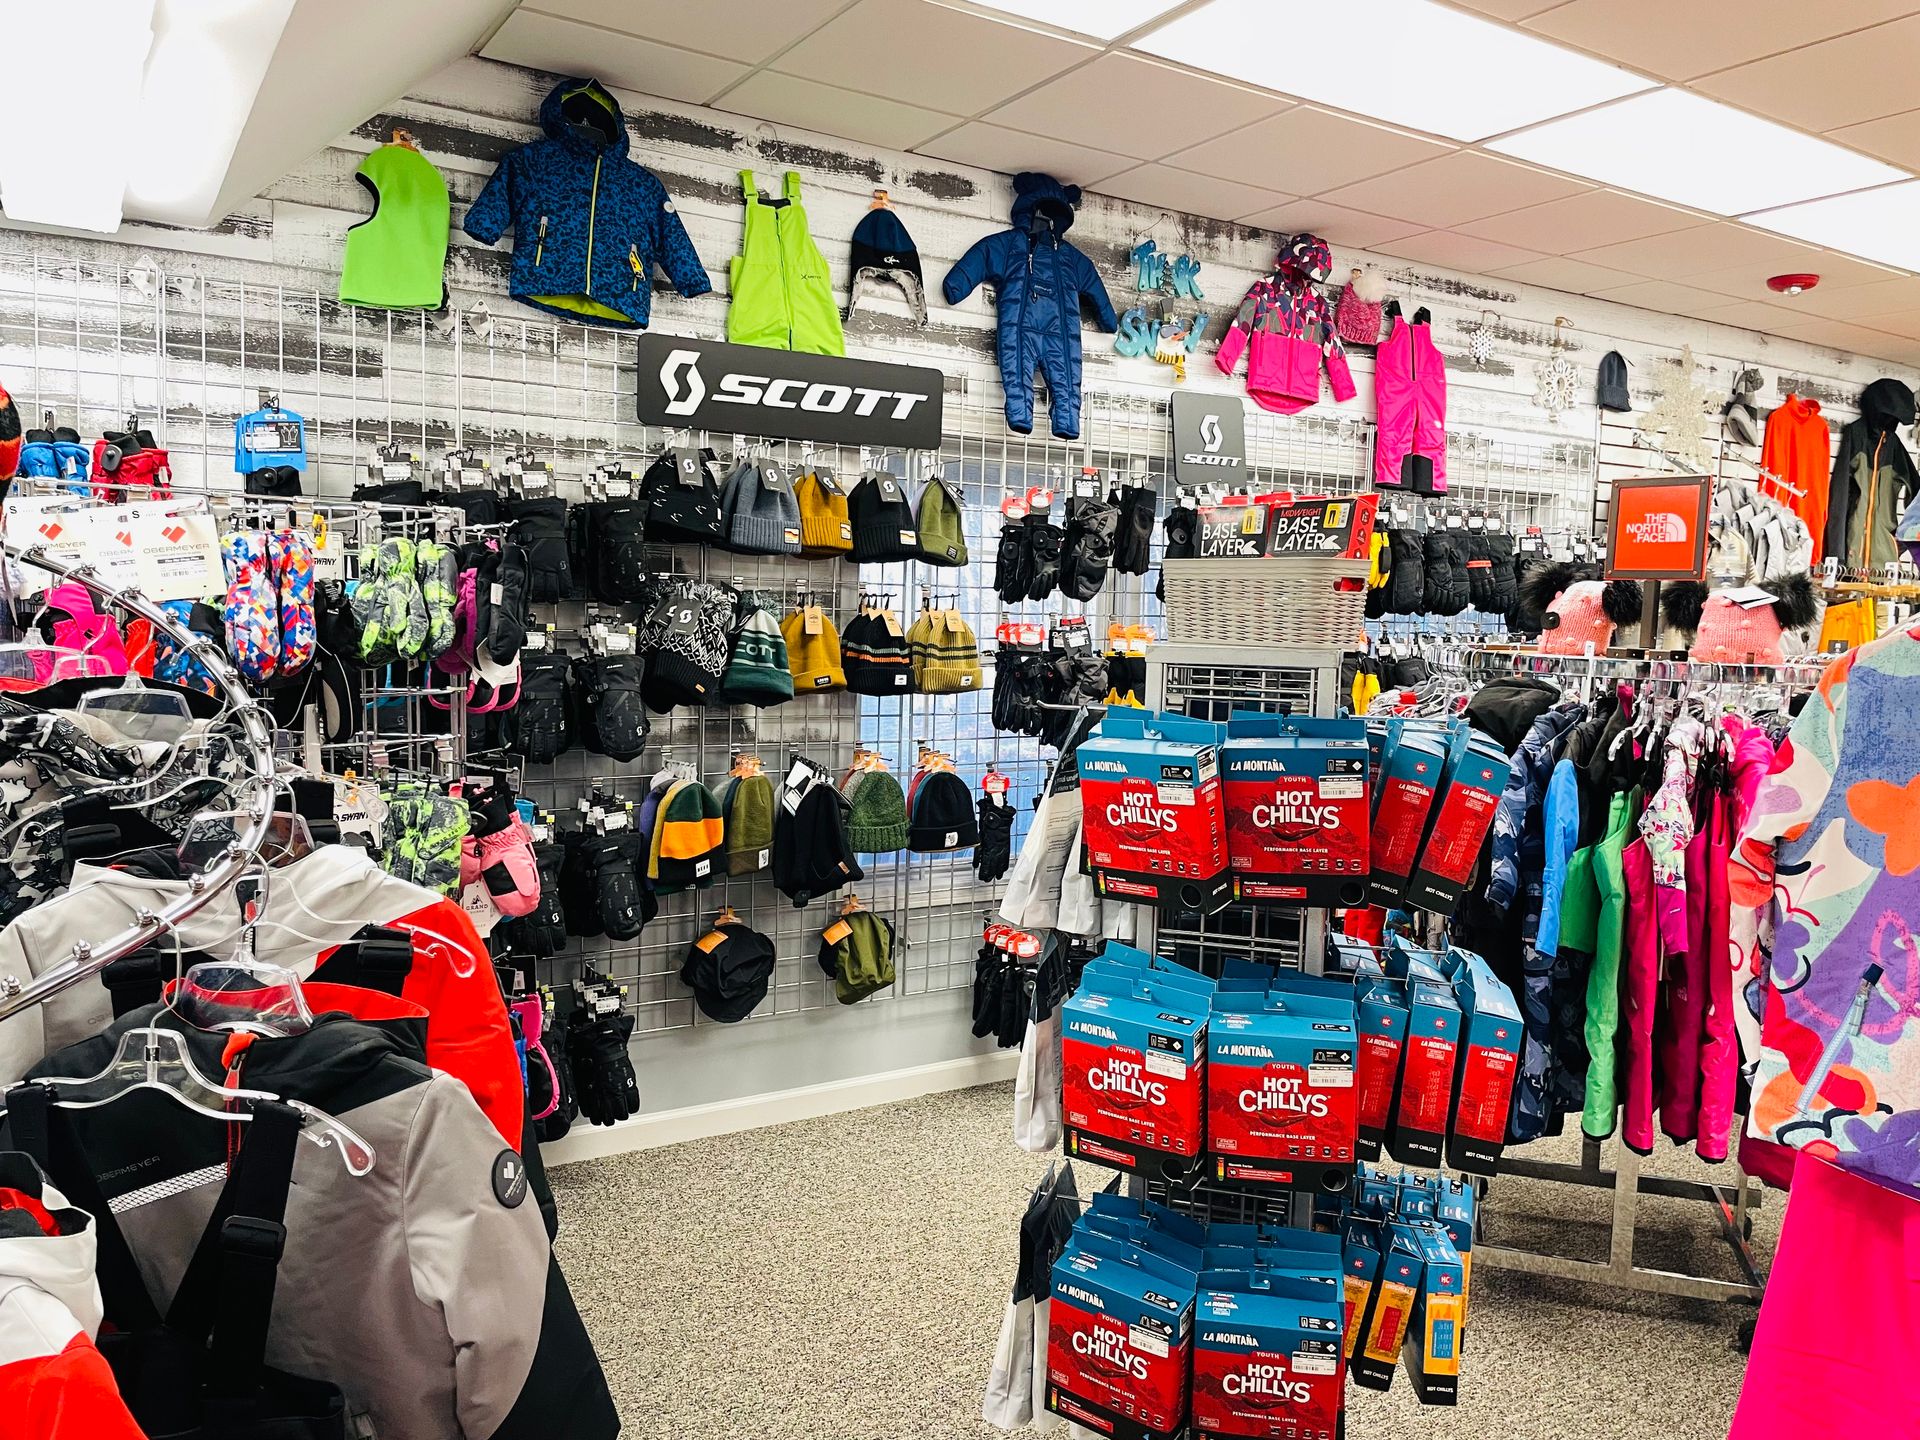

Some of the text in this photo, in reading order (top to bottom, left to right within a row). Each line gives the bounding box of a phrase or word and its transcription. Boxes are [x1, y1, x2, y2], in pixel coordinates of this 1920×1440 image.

[711, 373, 928, 420] SCOTT
[1182, 453, 1242, 467] SCOTT
[9, 506, 18, 514] S
[132, 510, 140, 519] S
[1280, 507, 1322, 517] MIDWEIGHT
[1277, 516, 1320, 534] BASE
[1644, 513, 1667, 523] THE
[1202, 522, 1239, 540] BASE
[1626, 523, 1665, 534] NORTH
[1274, 533, 1325, 551] LAYER
[1636, 533, 1665, 543] FACE
[142, 543, 210, 554] OBERMEYER
[1200, 538, 1244, 556] LAYER
[1085, 761, 1093, 771] LA
[1230, 761, 1241, 771] LA
[1482, 770, 1492, 779] HC
[1122, 791, 1153, 807] HOT
[1276, 791, 1314, 806] HOT
[1106, 804, 1178, 833] CHILLYS
[1252, 805, 1340, 830] CHILLYS
[1070, 1021, 1078, 1031] LA
[1115, 1046, 1136, 1055] YOUTH
[1218, 1045, 1228, 1054] LA
[1108, 1058, 1143, 1078] HOT
[1087, 1068, 1167, 1106] CHILLYS
[1263, 1077, 1302, 1093] HOT
[1238, 1090, 1328, 1117] CHILLYS
[1441, 1275, 1451, 1283] HC
[1057, 1283, 1067, 1293] LA
[1101, 1314, 1122, 1326] YOUTH
[1093, 1325, 1127, 1345] HOT
[1203, 1332, 1214, 1341] LA
[1072, 1331, 1148, 1380] CHILLYS
[1247, 1363, 1286, 1380] HOT
[1222, 1374, 1311, 1403] CHILLYS
